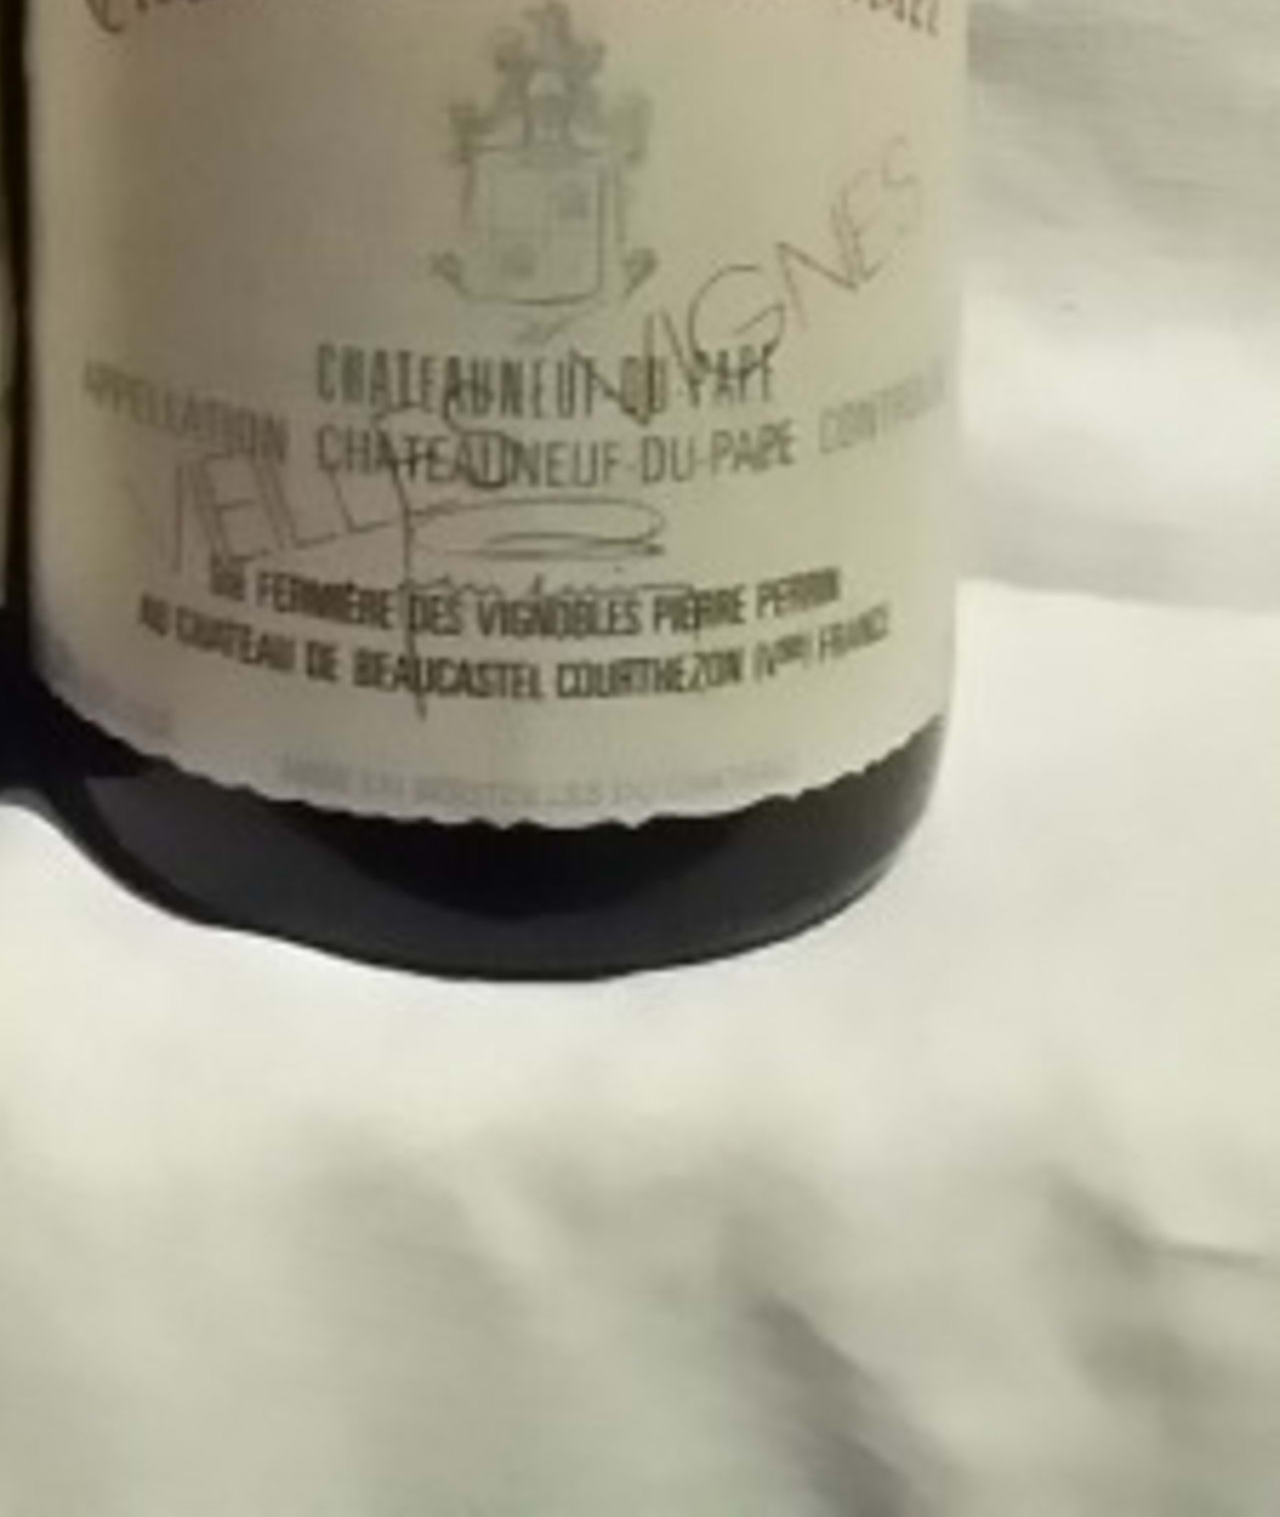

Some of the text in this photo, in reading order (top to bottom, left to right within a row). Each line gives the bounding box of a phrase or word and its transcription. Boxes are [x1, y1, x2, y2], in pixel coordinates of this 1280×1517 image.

[568, 132, 922, 426] VIGNES
[305, 638, 340, 684] DE
[350, 648, 548, 704] BEAUCASTEL
[554, 644, 747, 700] COURTHEZON
[819, 598, 892, 664] FRANCE
[403, 586, 464, 636] DES
[474, 594, 644, 640] VIGNOBLES
[653, 582, 747, 636] PIERRE
[755, 564, 842, 622] PERRIN
